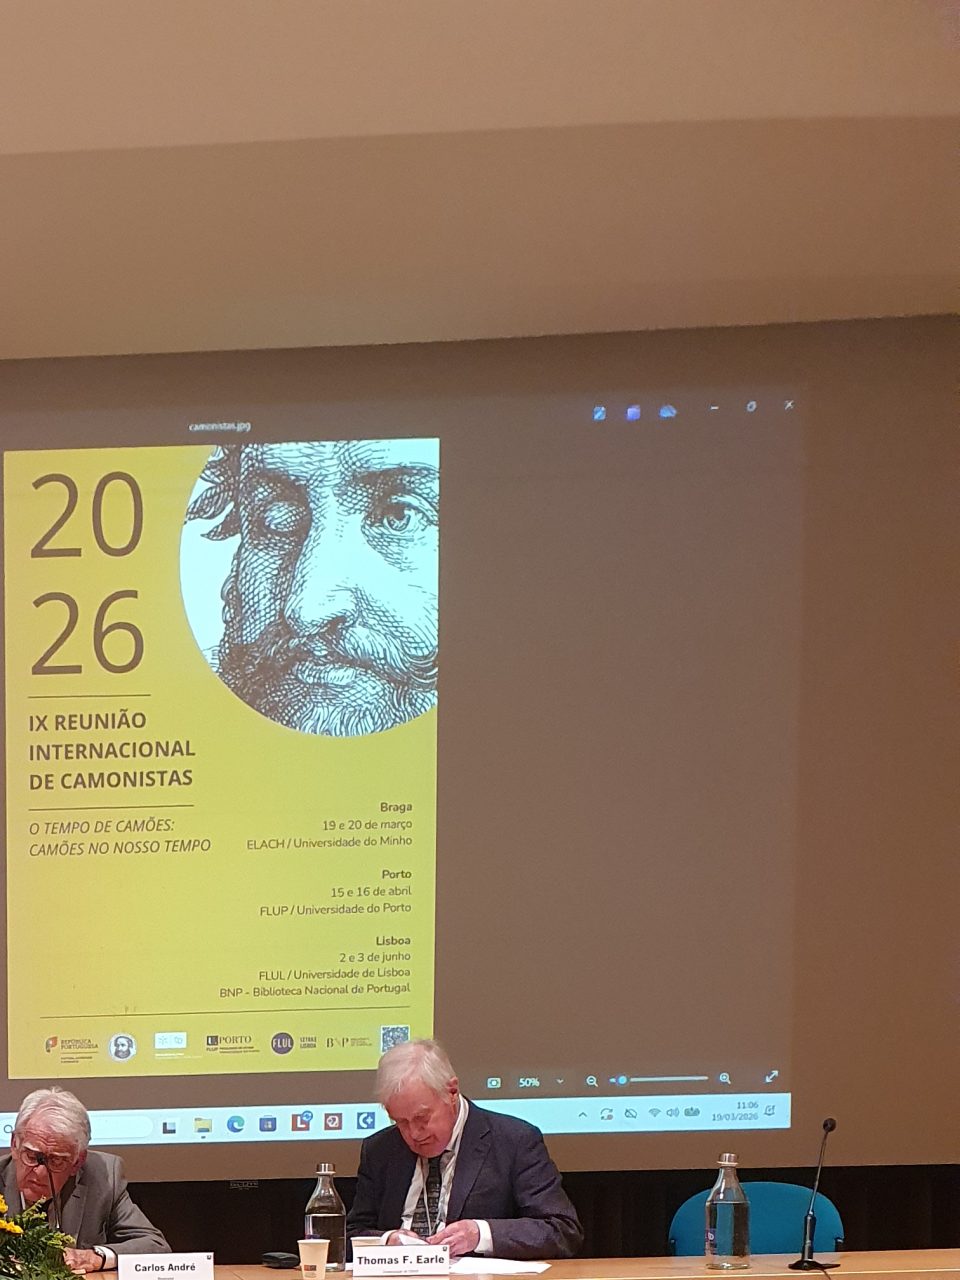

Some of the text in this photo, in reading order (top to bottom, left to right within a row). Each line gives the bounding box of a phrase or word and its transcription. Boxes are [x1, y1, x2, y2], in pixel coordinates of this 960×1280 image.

[30, 471, 144, 559] 20
[30, 589, 145, 675] 26
[29, 708, 147, 732] IX REUNIÃO
[29, 740, 197, 761] INTERNACIONAL
[29, 769, 194, 790] DE CAMONISTAS
[380, 802, 413, 814] Braga
[29, 816, 176, 835] O TEMPO DE CAMÕES:
[323, 819, 413, 831] 19 e 20 de março
[29, 838, 212, 857] CAMÕES NO NOSSO TEMPO
[247, 835, 413, 850] ELACH / Universidade do Minho
[381, 869, 412, 880] Porto
[330, 885, 412, 898] 15 e 16 de abril
[260, 902, 412, 917] FLUP / Universidade do Porto
[376, 936, 411, 946] Lisboa
[339, 951, 411, 964] 2 e 3 de junho
[259, 966, 411, 981] FLUL / Universidade de Lisboa
[219, 987, 243, 998] BNP
[253, 985, 302, 998] Biblioteca
[304, 984, 349, 996] Nacional
[351, 984, 364, 994] de
[366, 982, 411, 995] Portugal
[219, 1035, 252, 1044] PORTO
[272, 1038, 293, 1049] FLUL
[518, 1077, 540, 1088] 50%
[737, 1101, 759, 1110] 11:06
[711, 1112, 759, 1121] 19/03/2026
[357, 1254, 445, 1265] Thomas F. Earle
[134, 1262, 196, 1272] Carlos André
